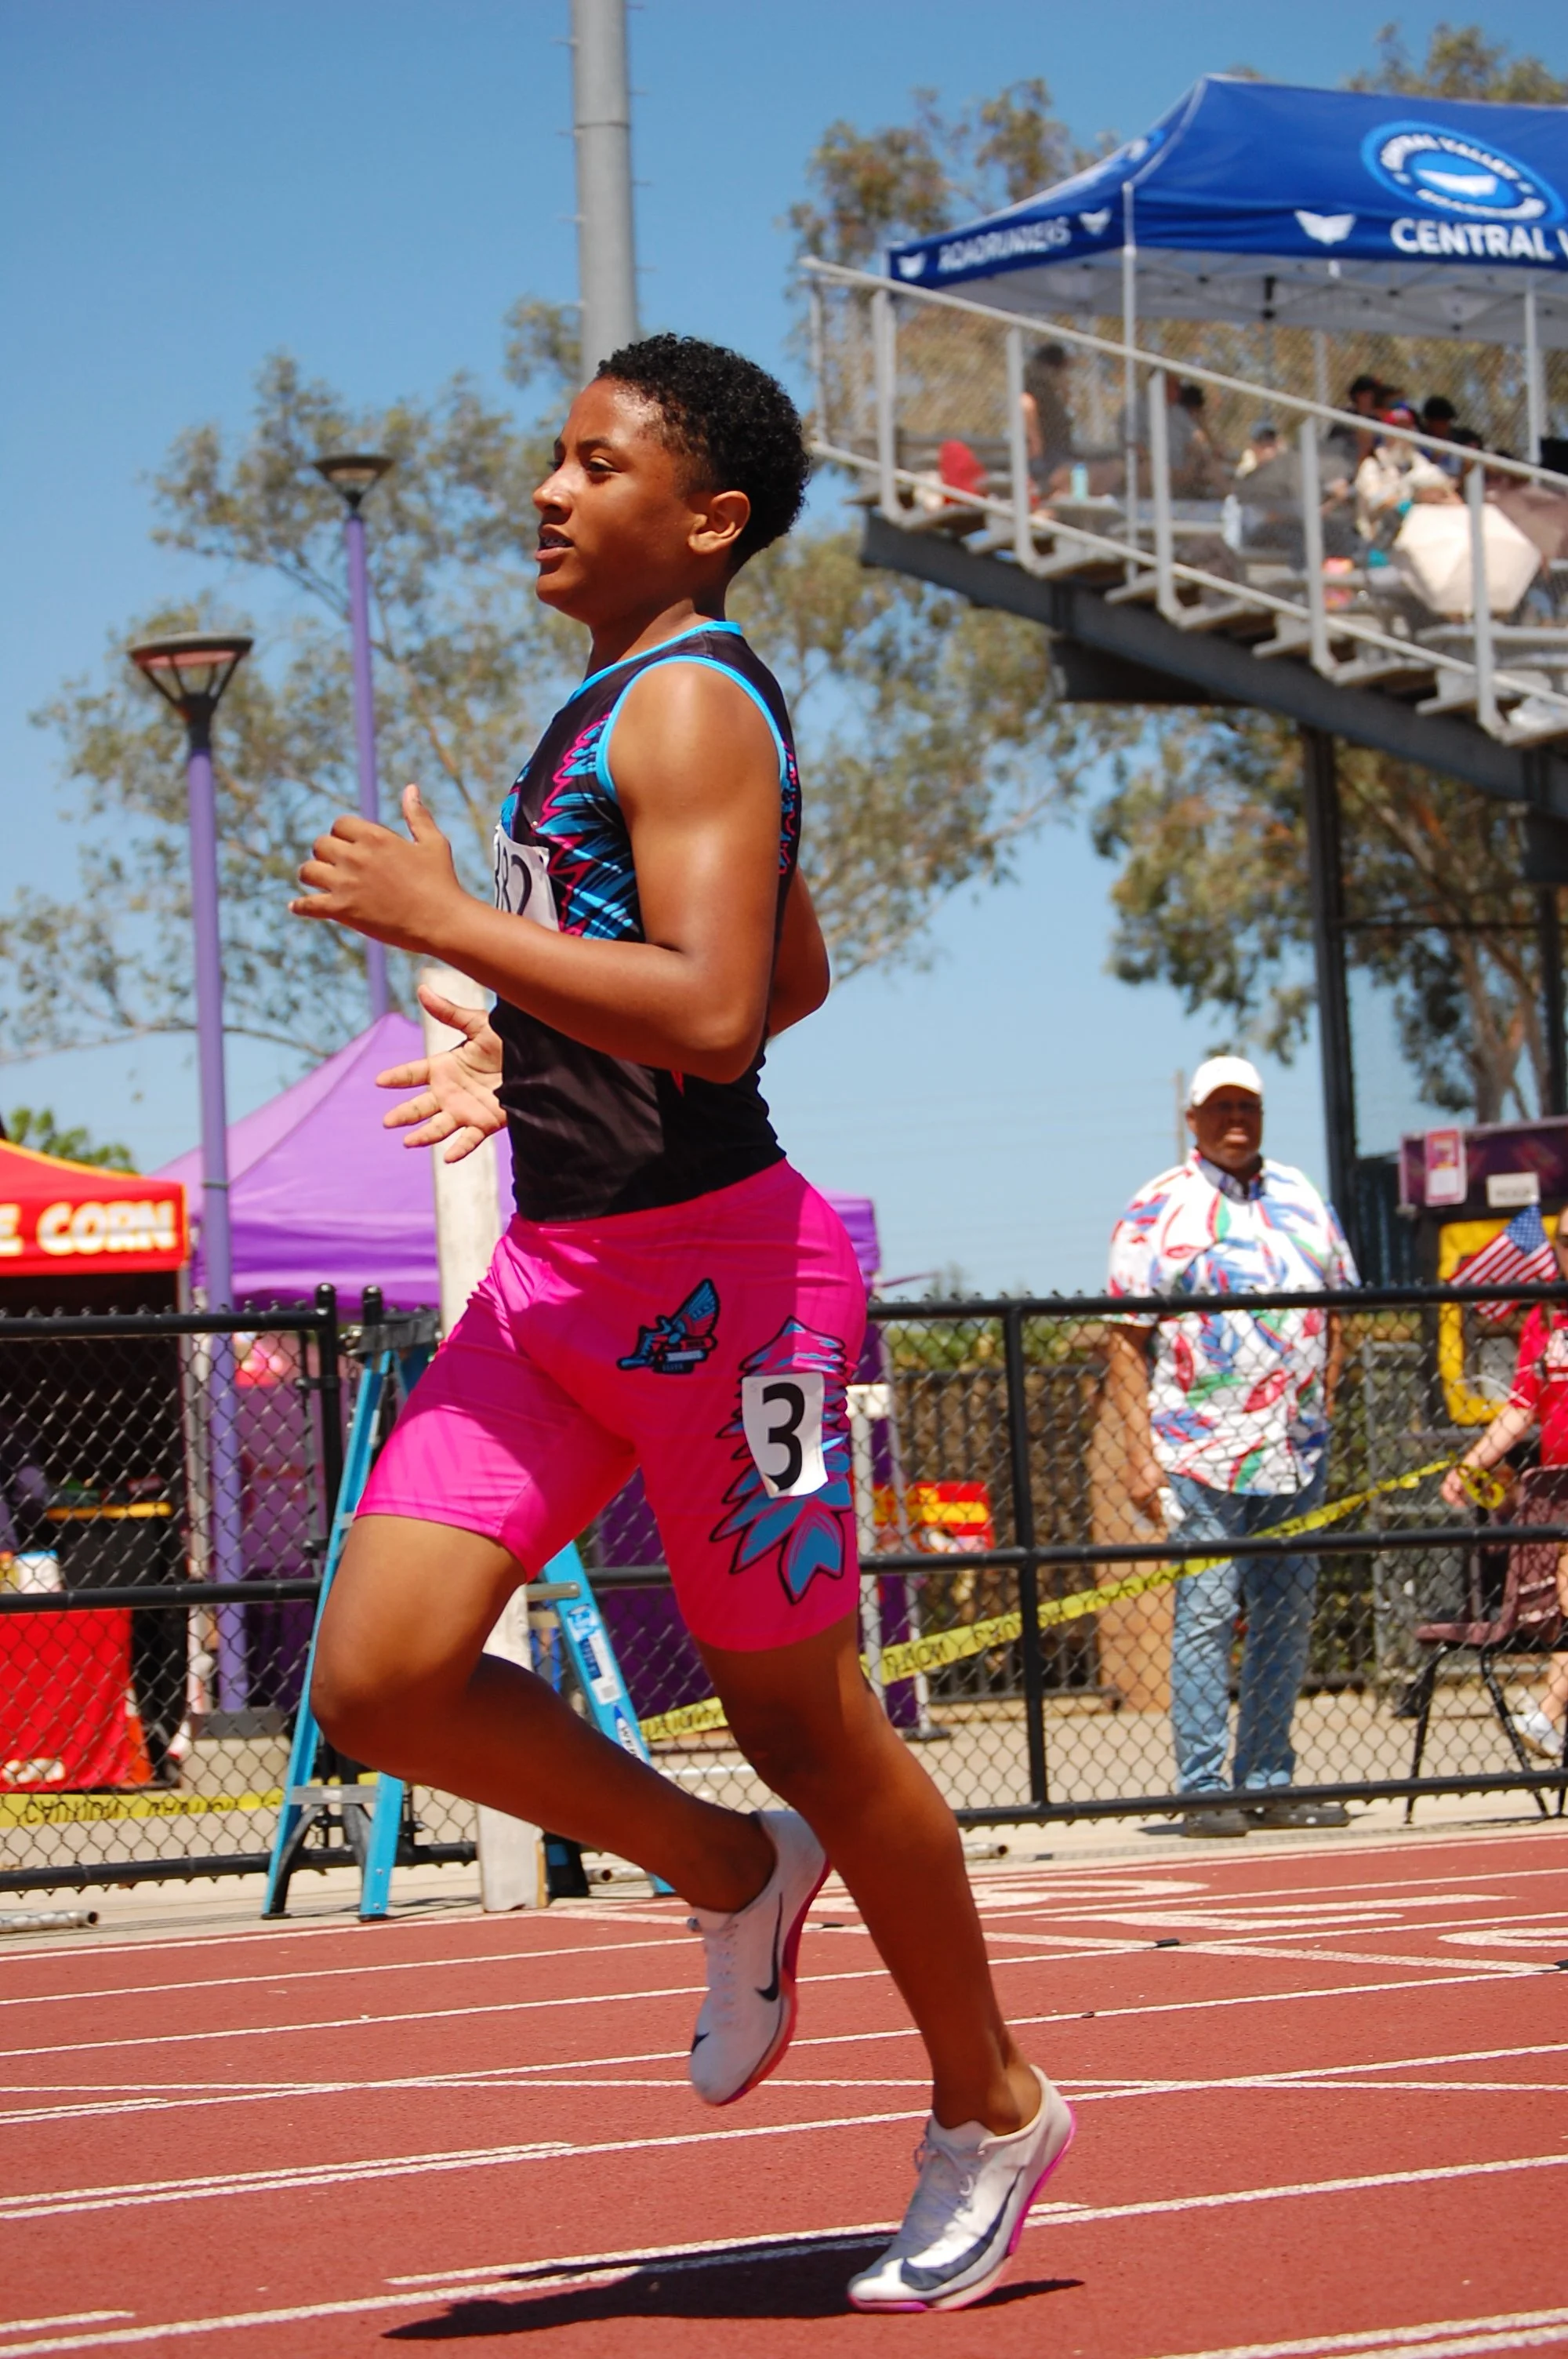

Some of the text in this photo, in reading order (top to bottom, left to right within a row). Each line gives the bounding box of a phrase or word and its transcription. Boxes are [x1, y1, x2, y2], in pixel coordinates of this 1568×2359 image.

[1390, 217, 1555, 261] CENTRAL
[37, 1200, 176, 1256] CORN
[763, 1383, 805, 1491] 3
